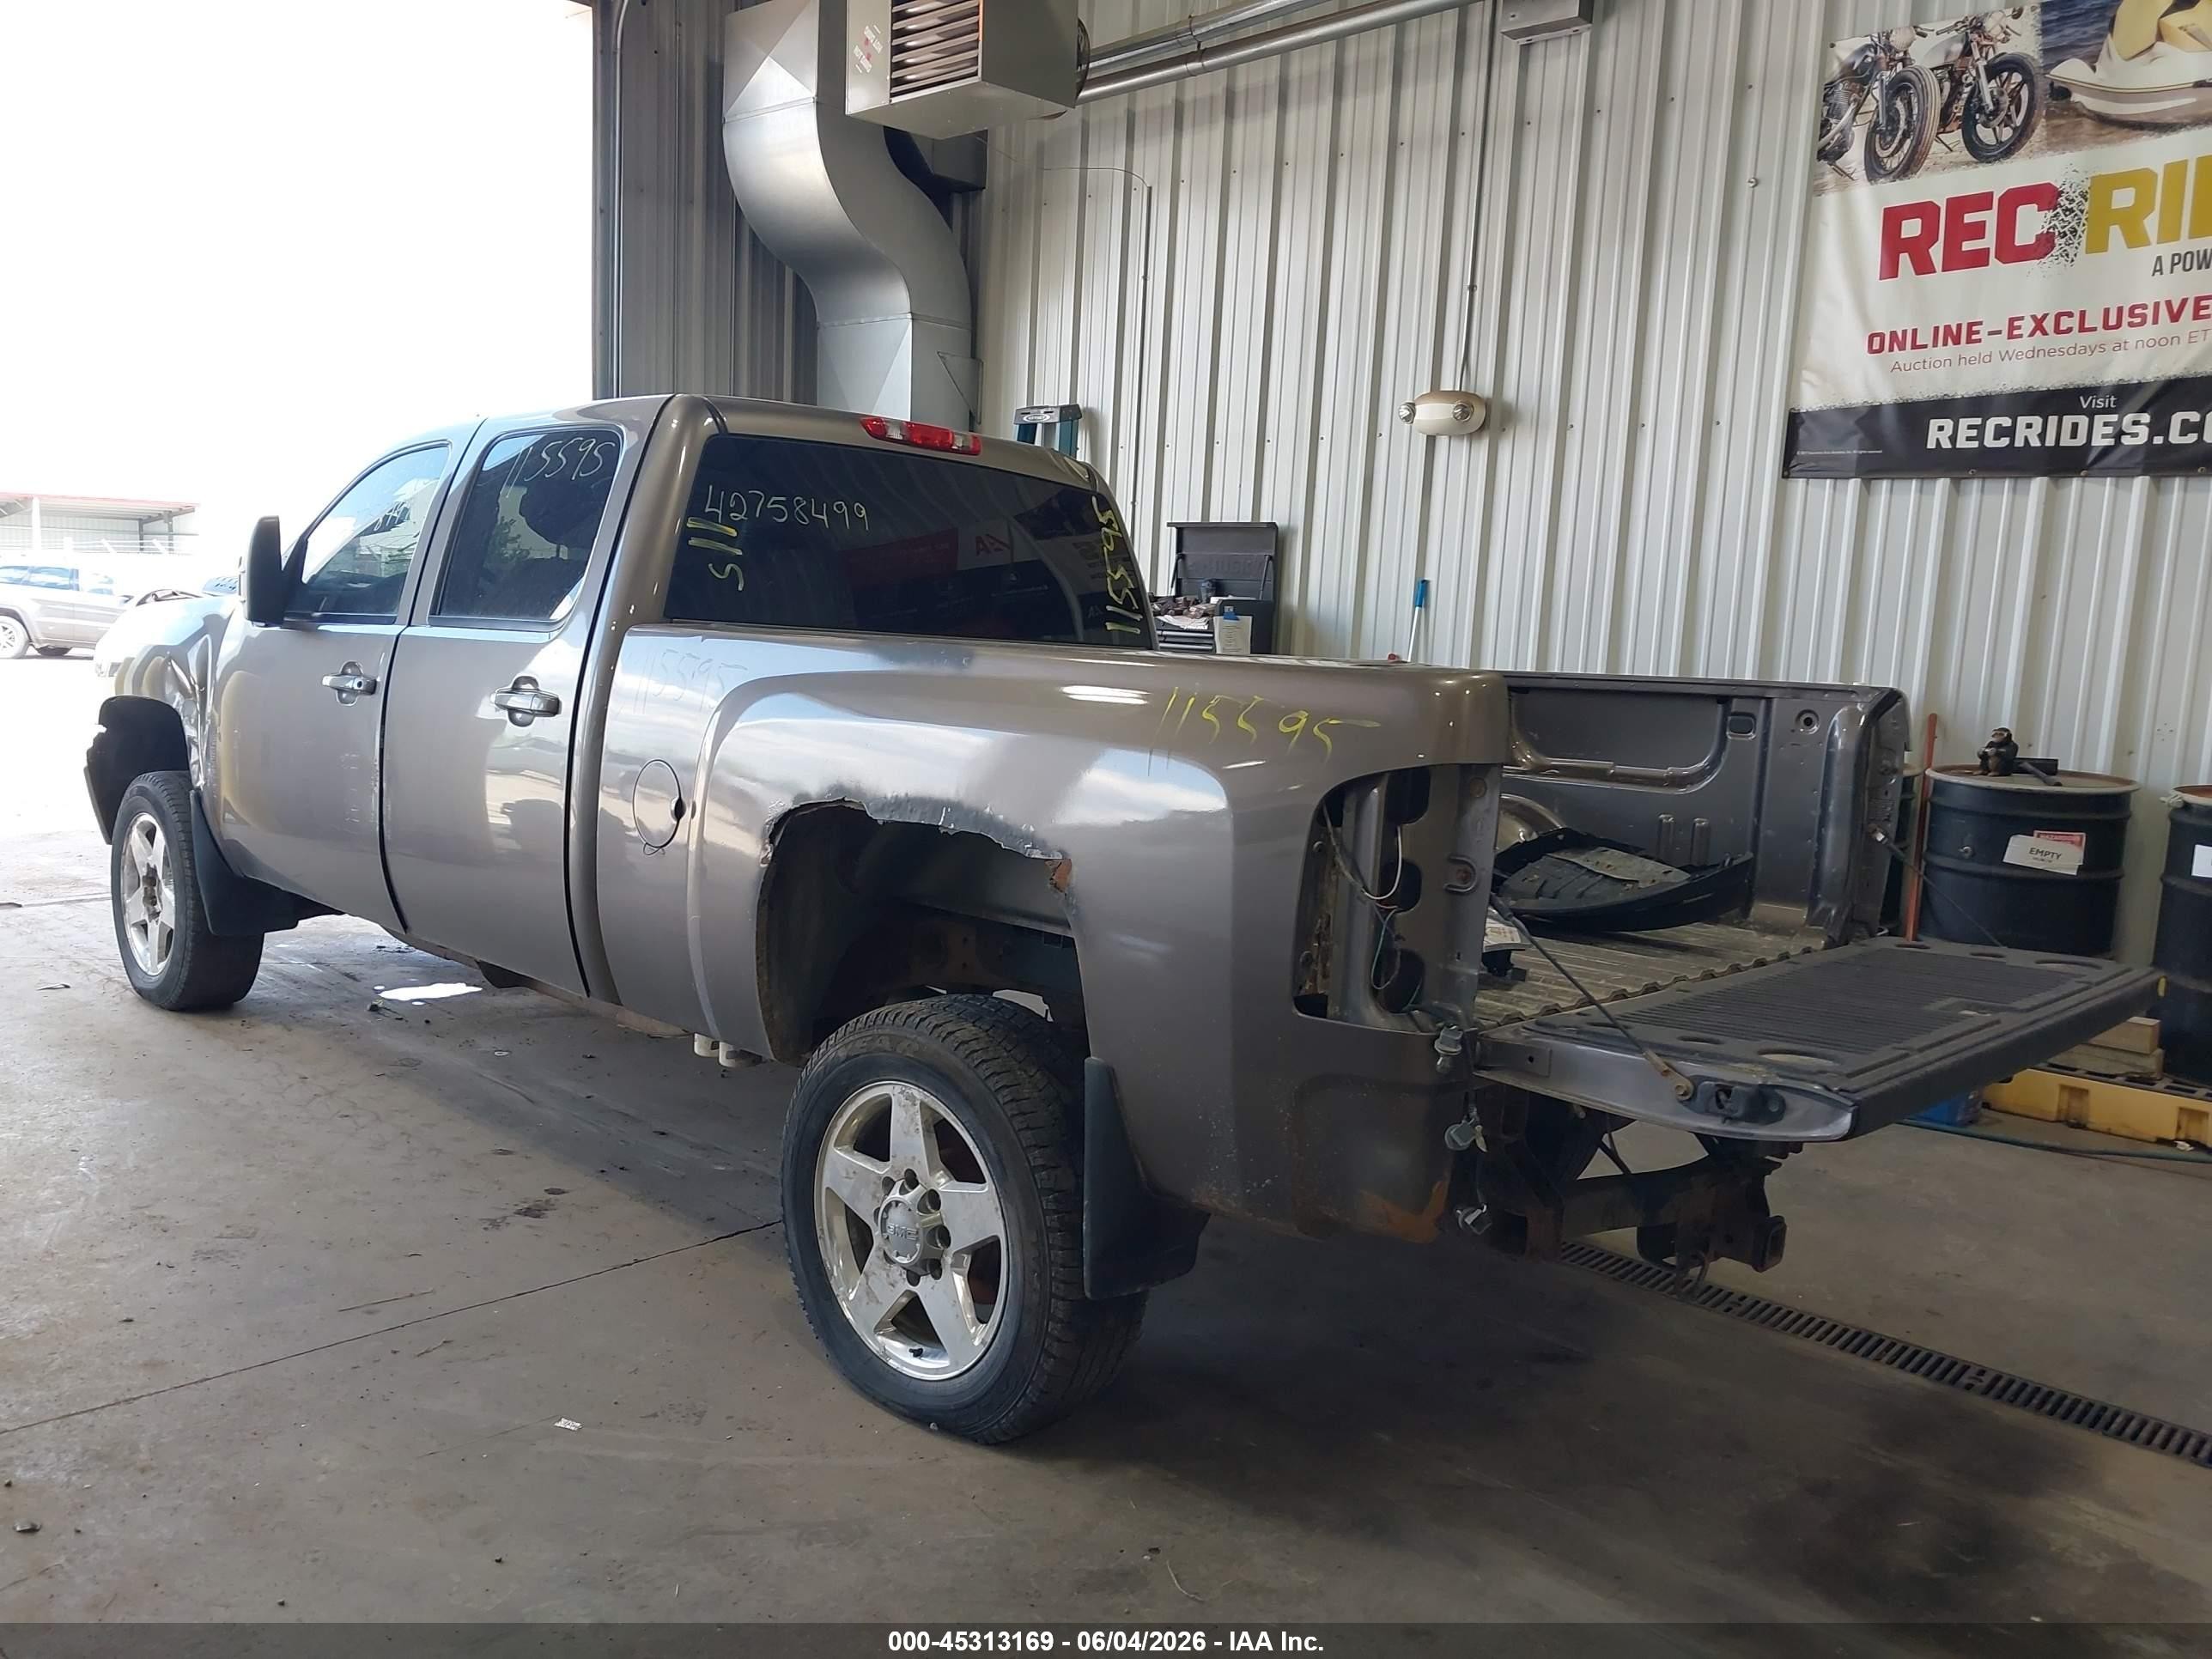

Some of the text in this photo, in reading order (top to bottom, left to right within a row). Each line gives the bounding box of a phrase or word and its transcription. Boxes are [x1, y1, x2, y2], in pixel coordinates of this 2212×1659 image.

[1878, 154, 2212, 282] REC RI
[2152, 255, 2164, 276] A
[1867, 294, 2212, 355] ONLINE-EXCLUSIVE
[1890, 328, 2212, 373] Auction held Wednesdays at noon ET
[2079, 395, 2118, 409] Visit
[500, 436, 616, 499] 115595
[704, 484, 870, 531] 42758499
[1148, 686, 1381, 764] 115595
[2028, 847, 2062, 860] EMPTY
[885, 1223, 918, 1241] GMC
